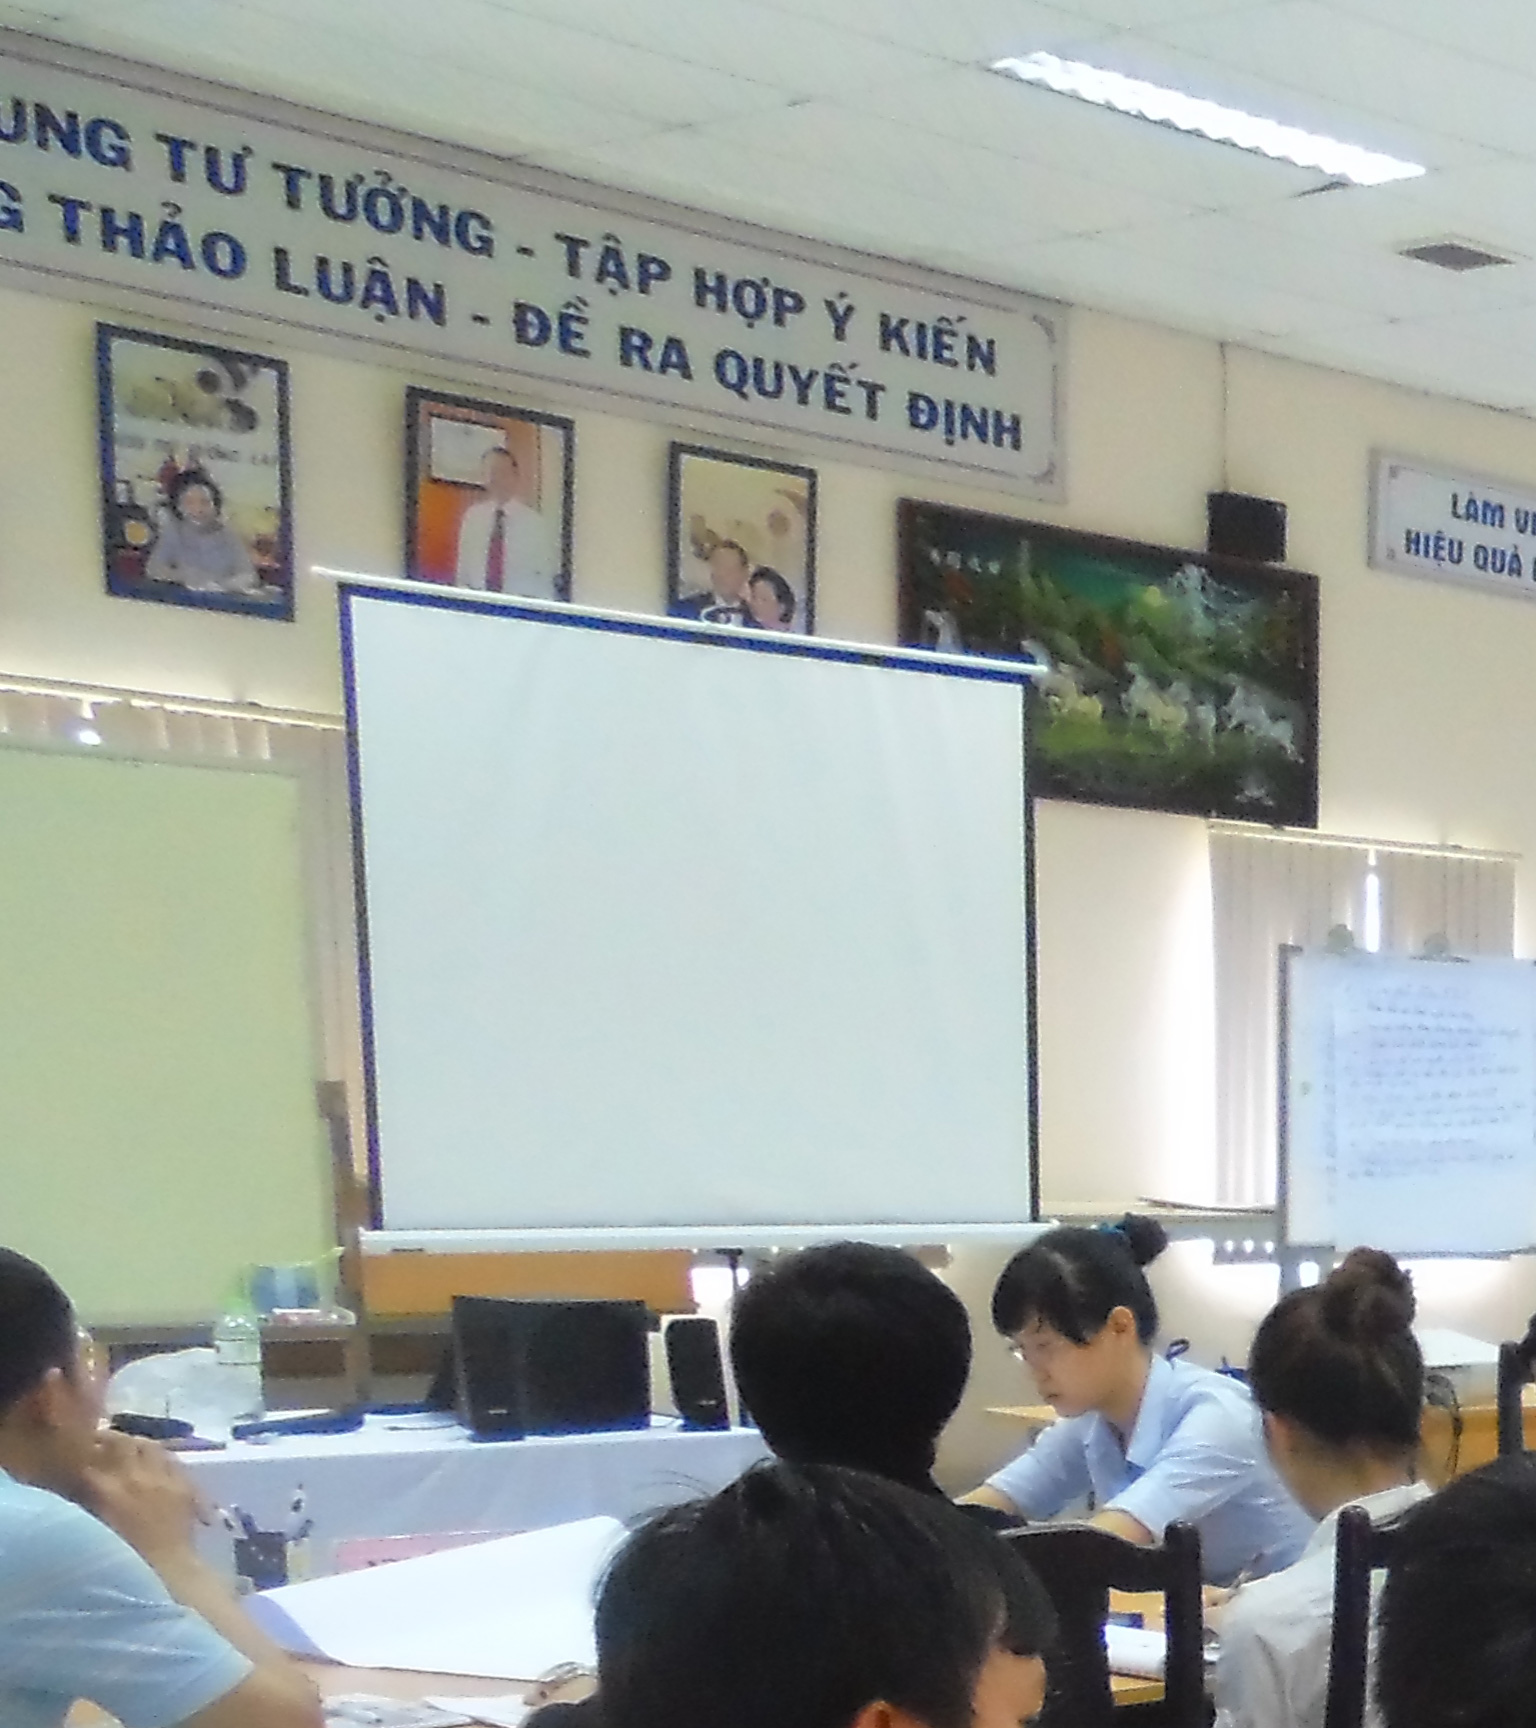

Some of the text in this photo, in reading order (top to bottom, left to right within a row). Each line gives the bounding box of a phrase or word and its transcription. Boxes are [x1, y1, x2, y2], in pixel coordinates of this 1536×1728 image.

[48, 193, 247, 280] THẢO
[273, 246, 447, 327] LUẬN
[513, 295, 591, 358] ĐỀ
[618, 325, 693, 380] RA
[714, 348, 887, 421] QUYẾT
[906, 391, 1021, 451] ĐỊNH
[153, 131, 254, 195] TƯ
[271, 162, 495, 258] TƯỞNG
[554, 232, 671, 295] TẬP
[694, 267, 806, 328] HỢP
[824, 291, 855, 342] Ý
[879, 313, 996, 377] KIẾN
[1405, 529, 1463, 567] HIỆU
[1451, 492, 1504, 528] LÀM
